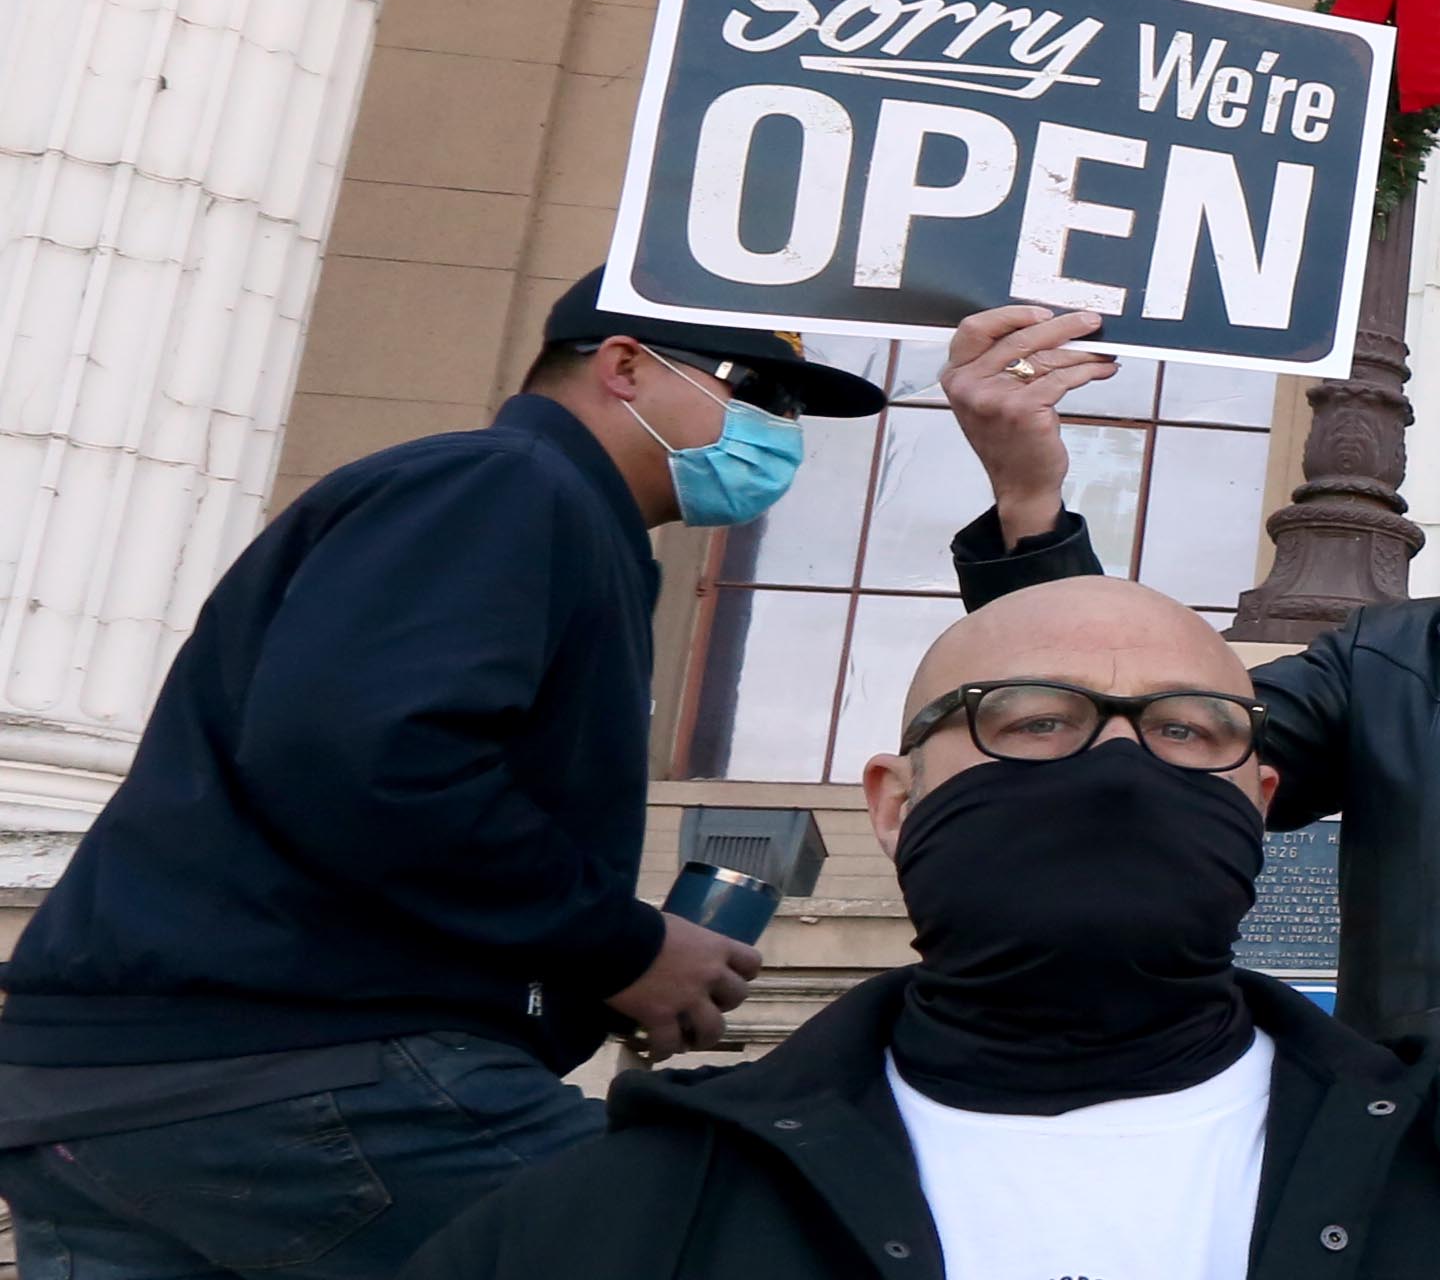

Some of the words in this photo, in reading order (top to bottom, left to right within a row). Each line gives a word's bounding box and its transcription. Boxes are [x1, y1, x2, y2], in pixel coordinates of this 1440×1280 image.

[1138, 22, 1336, 144] We're
[686, 83, 1315, 331] OPEN
[1283, 832, 1316, 844] CITY
